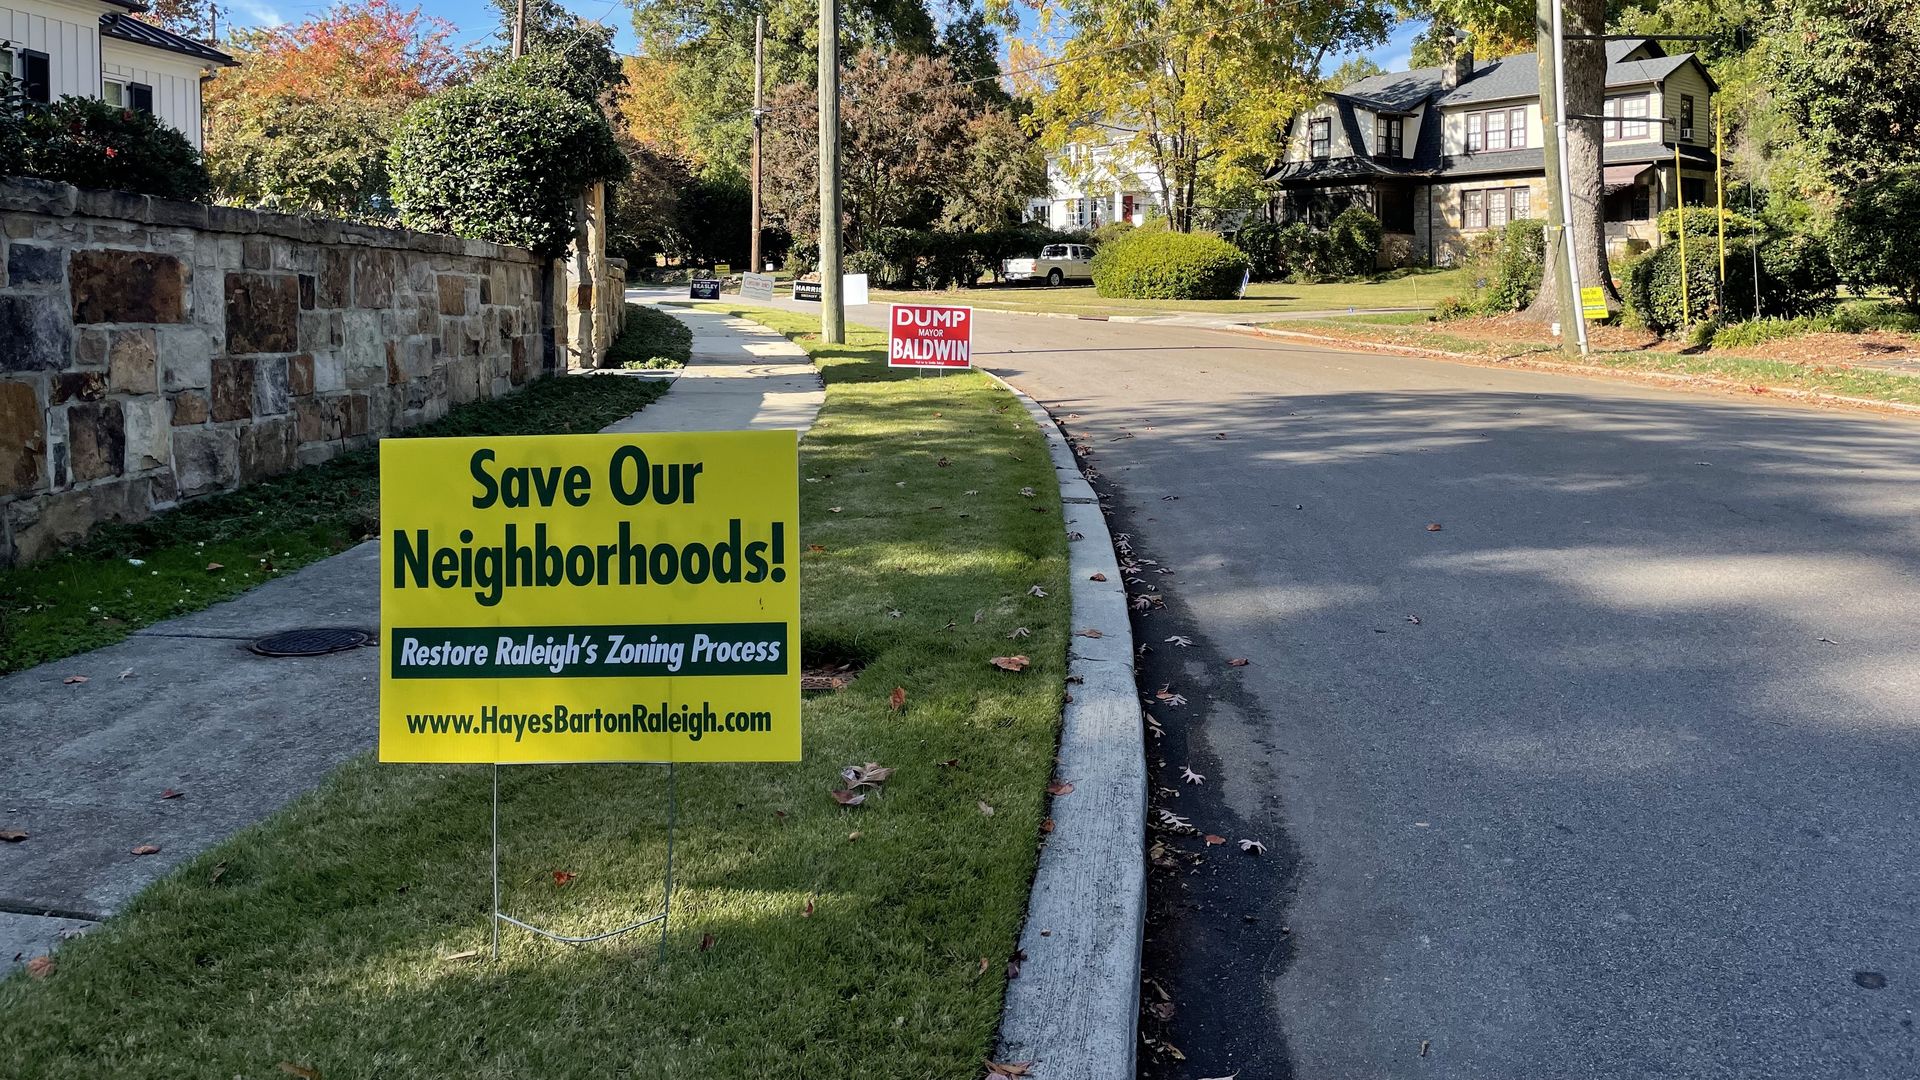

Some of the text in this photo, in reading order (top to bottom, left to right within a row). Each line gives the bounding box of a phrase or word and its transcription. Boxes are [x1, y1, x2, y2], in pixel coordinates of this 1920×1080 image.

[897, 308, 966, 328] DUMP
[918, 328, 944, 337] MAYOR
[893, 337, 968, 361] BALDWIN
[470, 445, 703, 509] Save Our
[394, 519, 786, 606] Neighborhoods!
[401, 634, 780, 673] Restore Raleigh's Zoning Process
[407, 702, 771, 742] www.HayesBartonRaleigh.com
